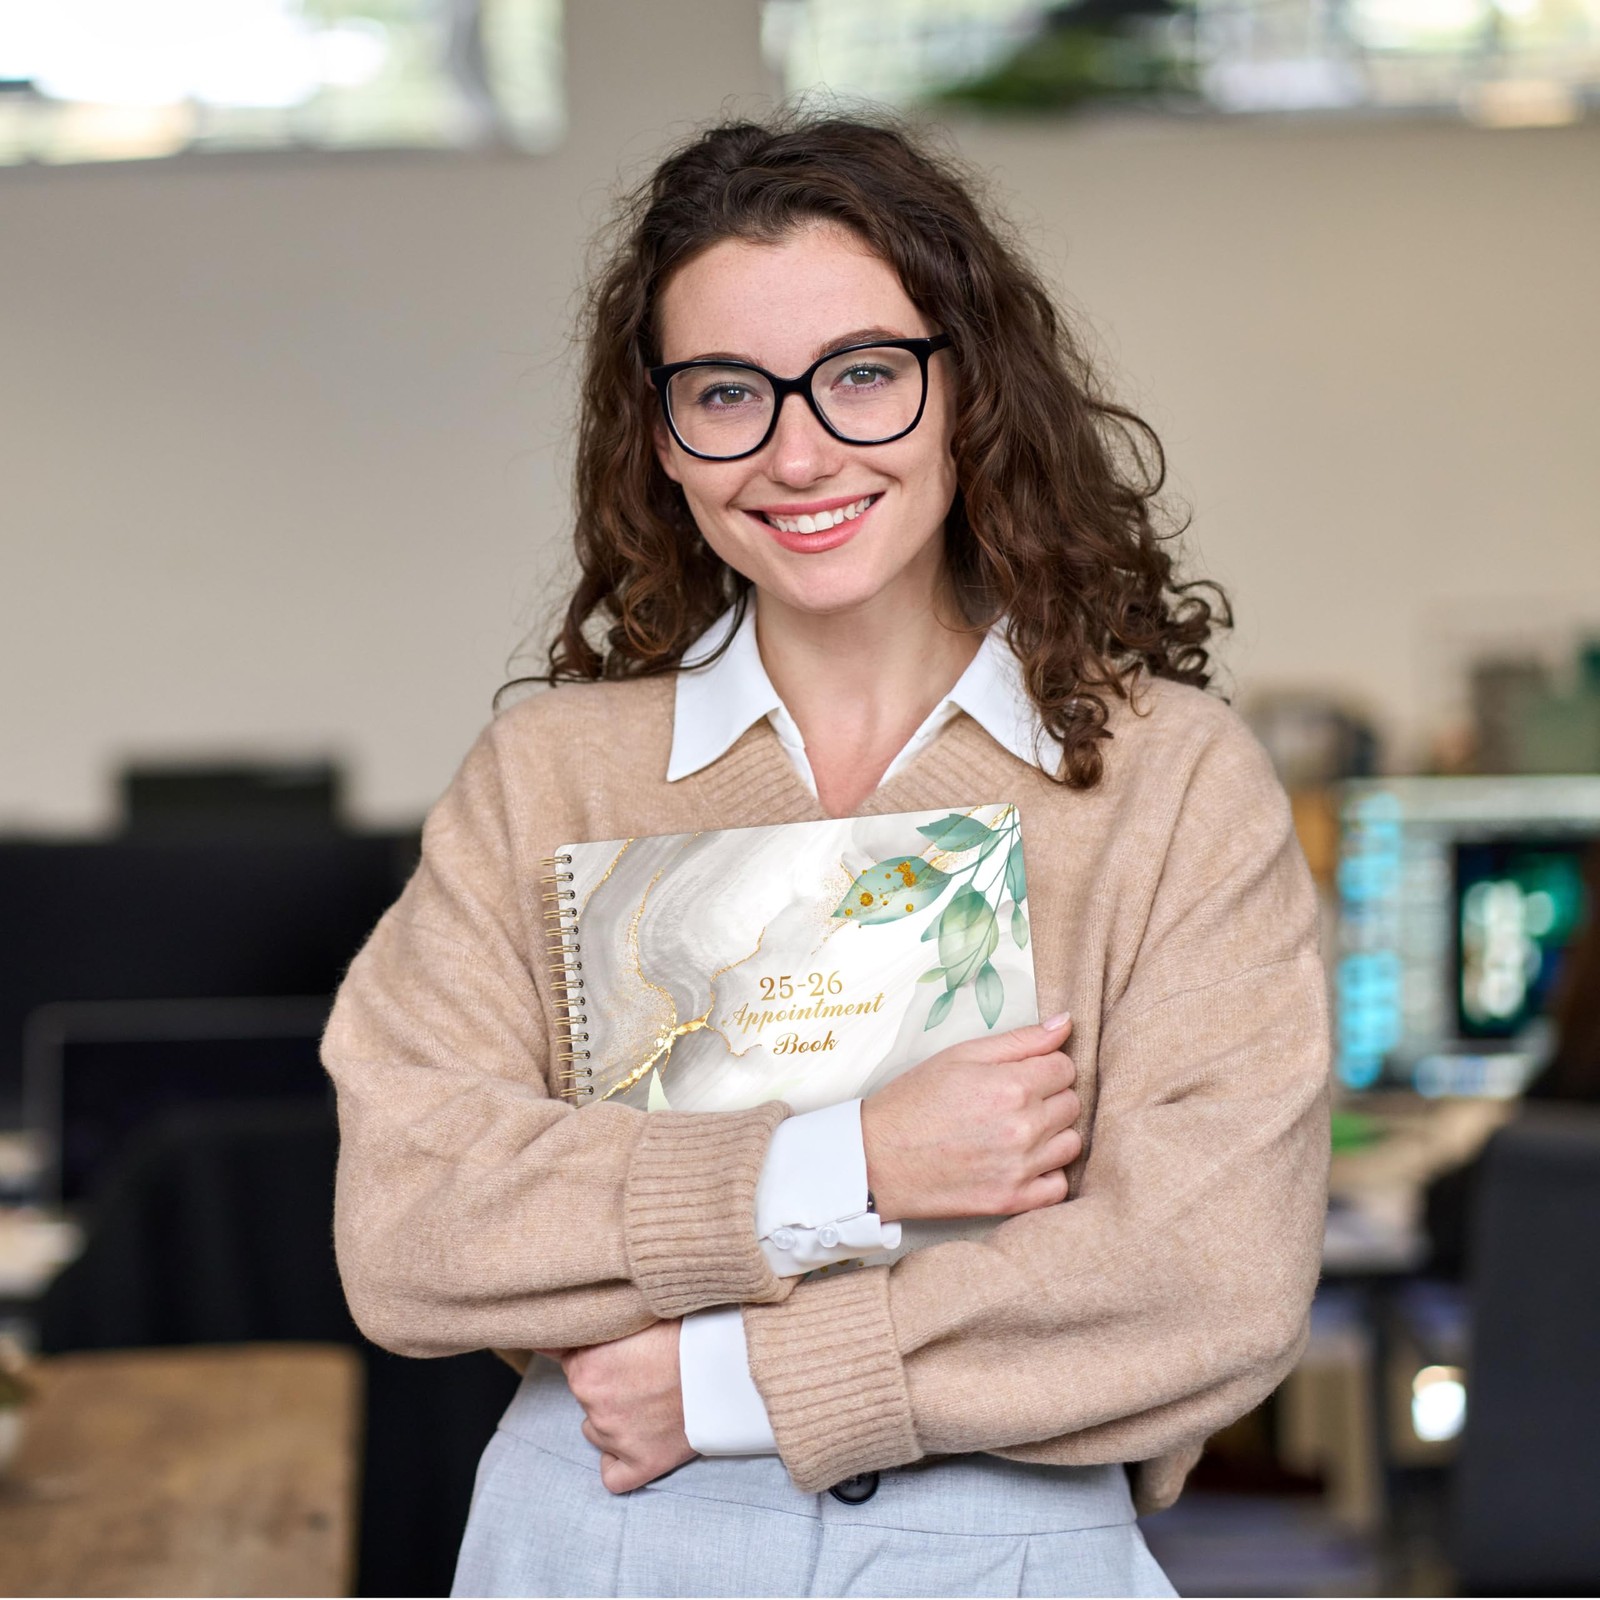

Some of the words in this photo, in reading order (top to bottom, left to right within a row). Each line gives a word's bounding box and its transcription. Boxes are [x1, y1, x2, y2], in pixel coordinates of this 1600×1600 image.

[759, 970, 843, 1001] 25-26
[722, 992, 885, 1034] Appointment
[773, 1030, 839, 1055] Book
